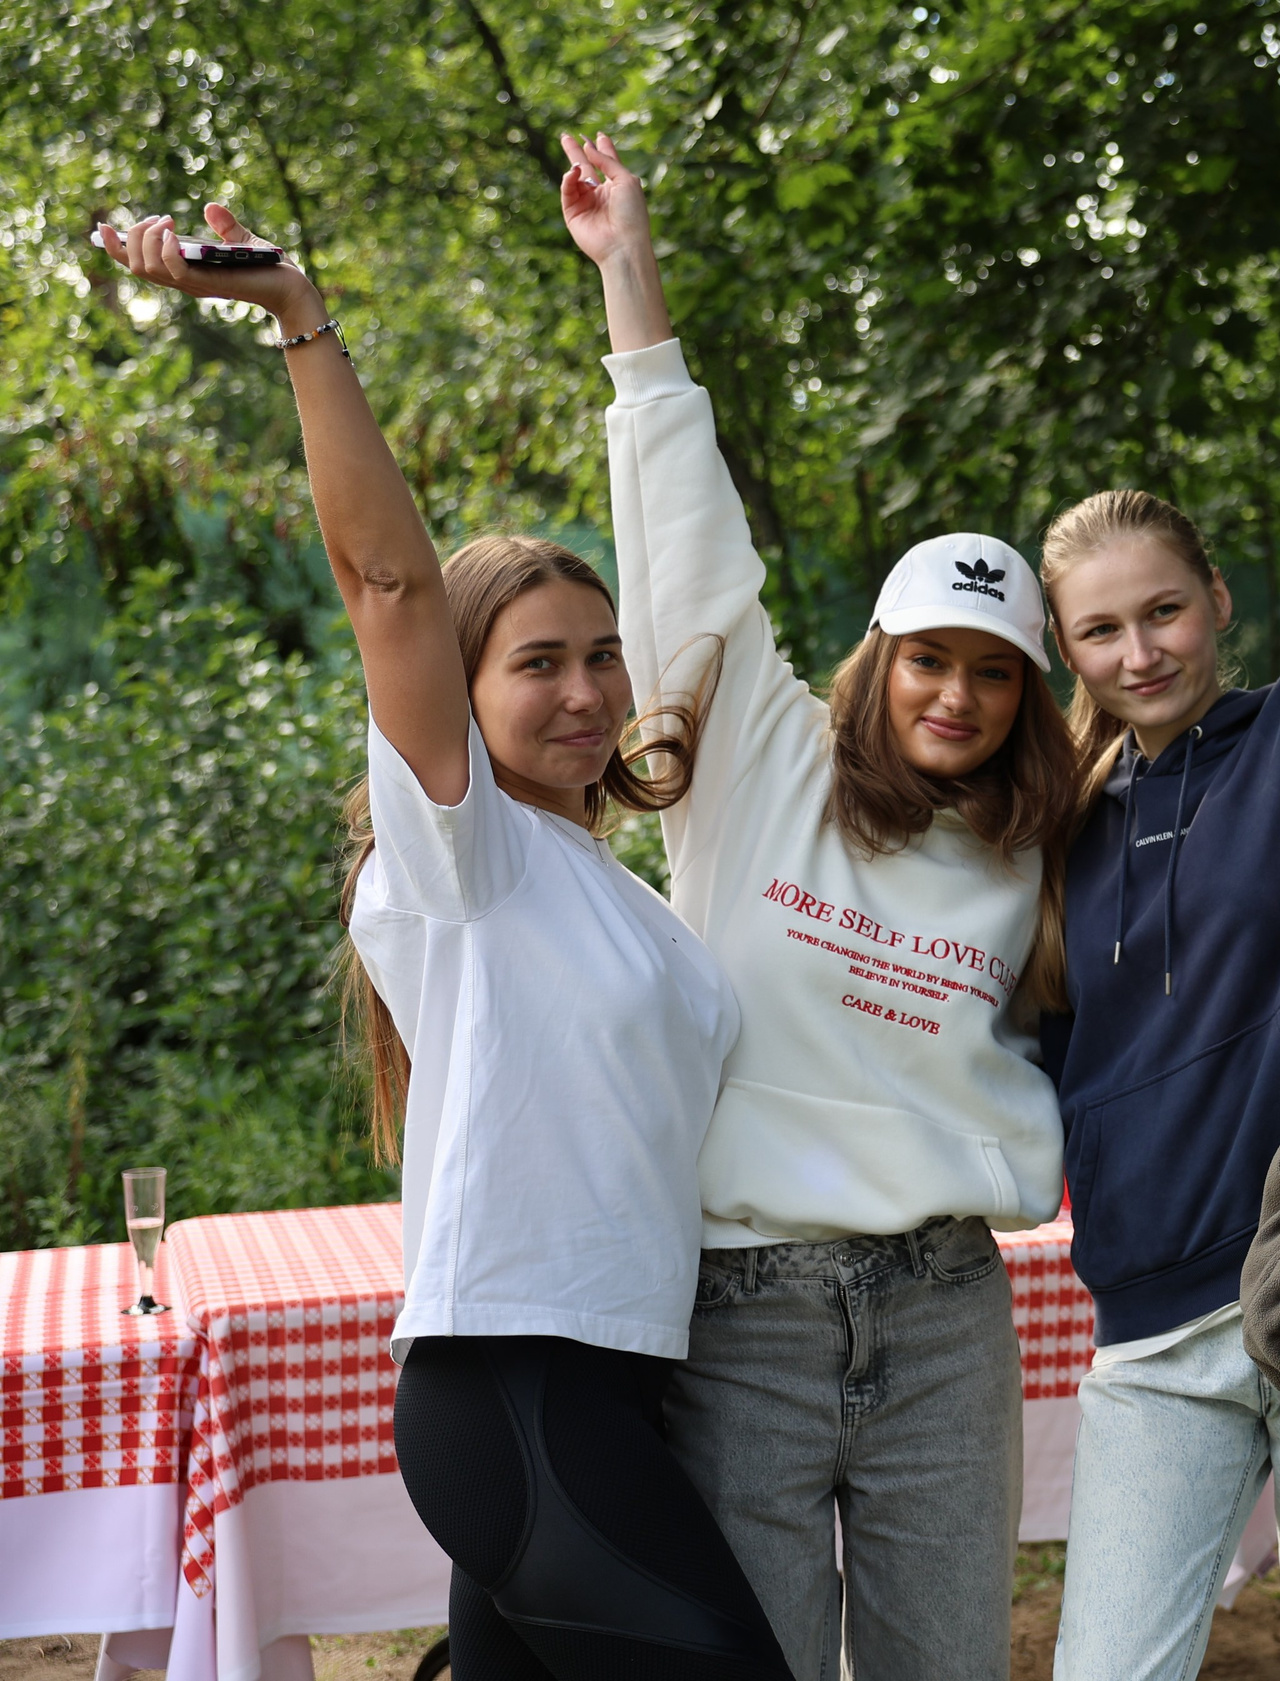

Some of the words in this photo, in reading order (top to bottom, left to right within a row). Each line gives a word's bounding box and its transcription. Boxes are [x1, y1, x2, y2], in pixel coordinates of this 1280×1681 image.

[952, 581, 1005, 602] adidas
[1135, 835, 1156, 847] CALVIN
[1156, 831, 1173, 841] KLEIN
[762, 879, 835, 922] MORE
[839, 908, 905, 947] SELF
[911, 935, 986, 971] LOVE
[821, 940, 871, 964] CHANGING
[872, 958, 890, 971] THE
[892, 963, 926, 981] WORLD
[926, 973, 941, 985] BY
[849, 965, 887, 985] BELIEVE
[888, 978, 900, 988] IN
[842, 995, 882, 1017] CARE
[884, 1009, 897, 1022] &
[899, 1012, 940, 1035] LOVE
